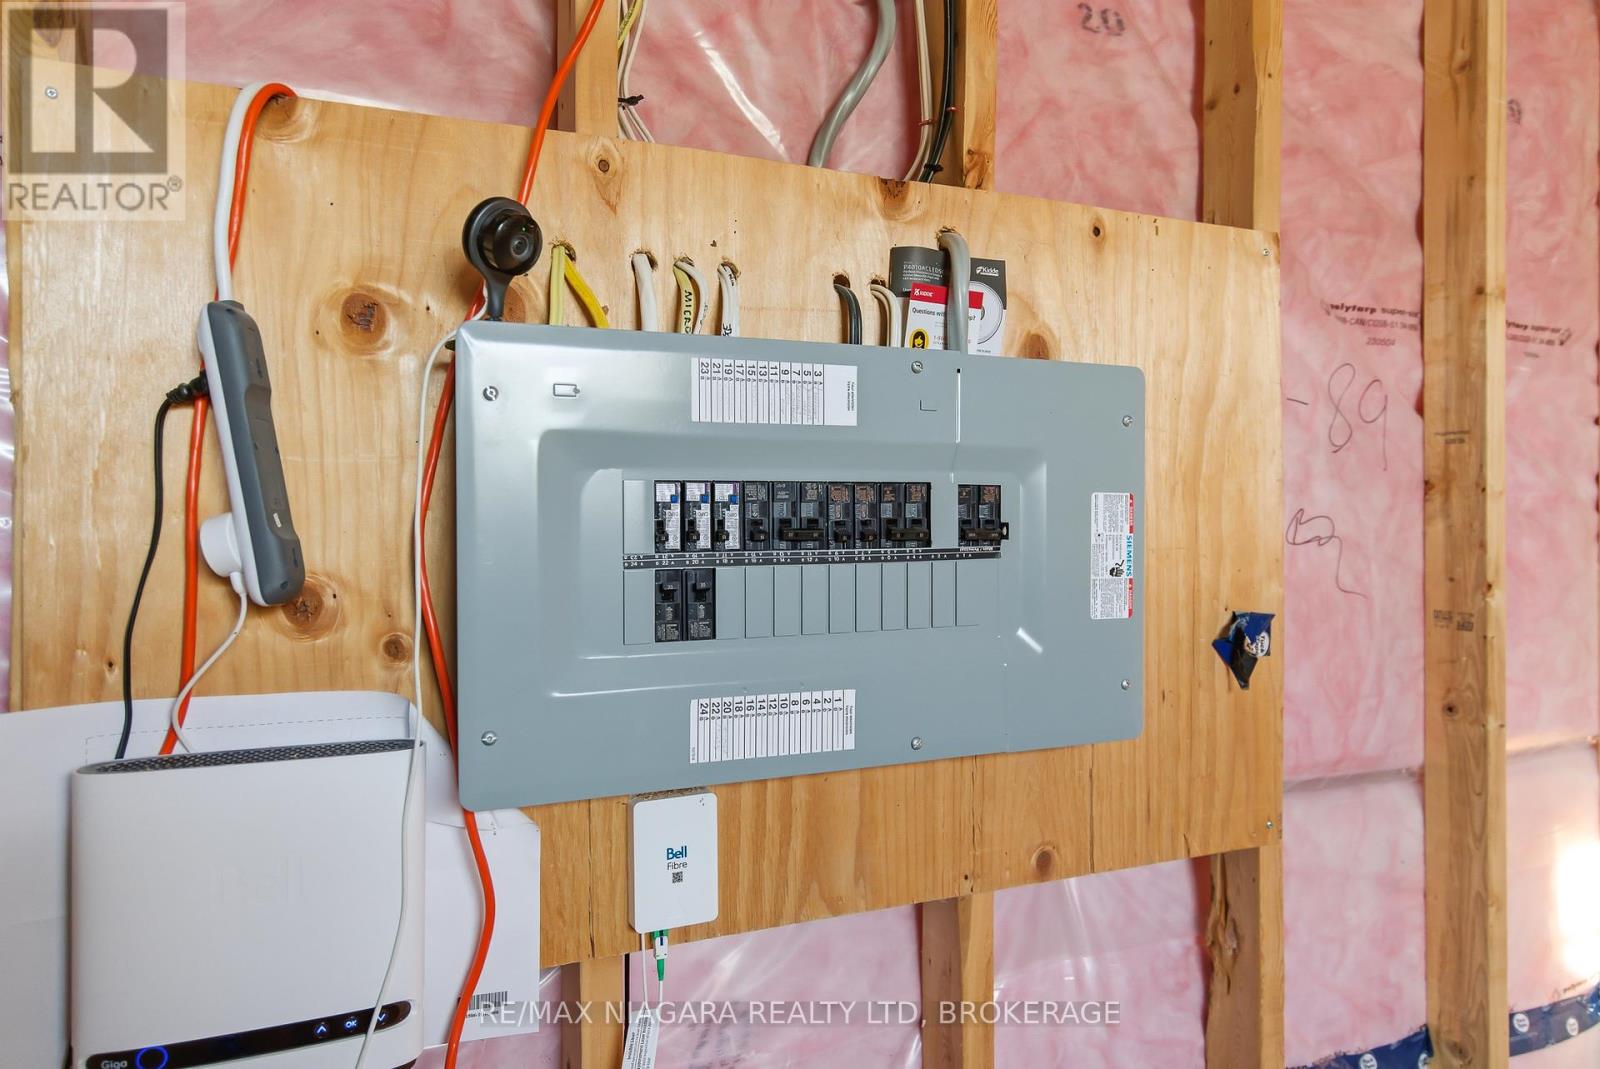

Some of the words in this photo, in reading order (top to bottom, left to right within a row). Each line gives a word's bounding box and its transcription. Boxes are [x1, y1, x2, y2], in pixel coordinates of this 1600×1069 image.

[912, 307, 935, 316] Questions
[701, 362, 709, 374] 23
[713, 362, 721, 374] 21
[724, 363, 732, 375] 19
[736, 364, 744, 375] 17
[748, 364, 756, 376] 15
[759, 365, 767, 376] 13
[770, 366, 778, 376] 11
[712, 702, 720, 714] 22
[724, 701, 731, 713] 20
[735, 700, 743, 712] 18
[747, 700, 754, 711] 16
[758, 699, 765, 710] 14
[769, 698, 777, 709] 12
[780, 697, 788, 708] 10
[700, 703, 708, 714] 24
[666, 845, 688, 860] Bell
[667, 862, 688, 870] Fibre
[346, 1020, 357, 1028] OK
